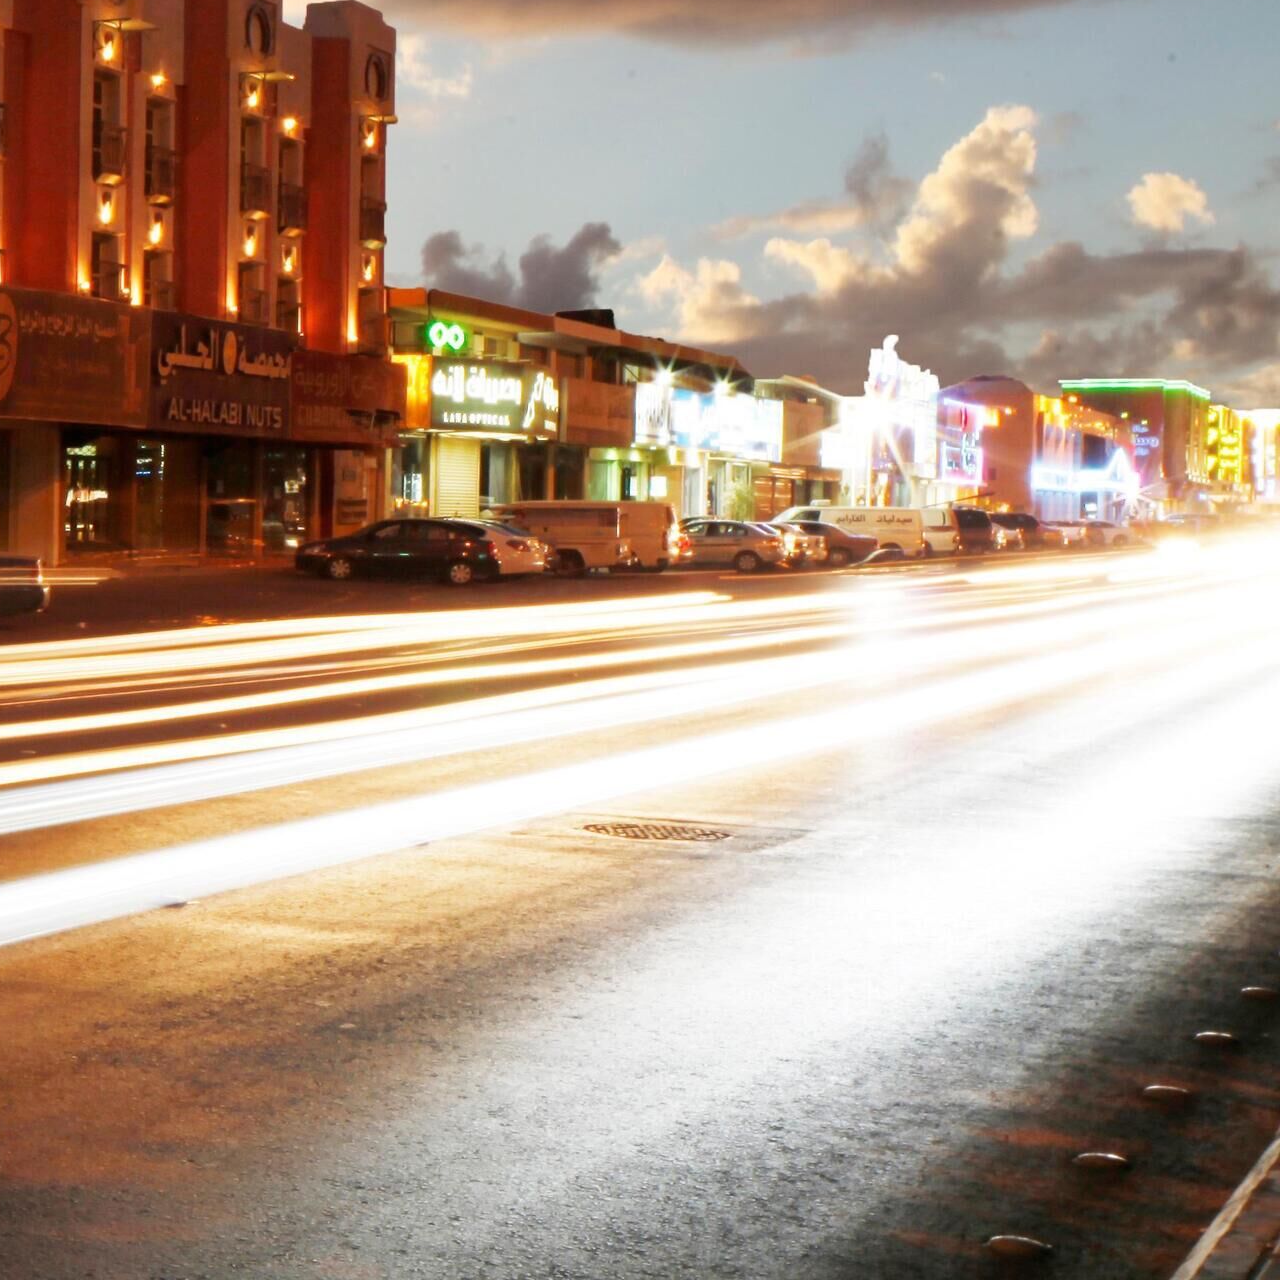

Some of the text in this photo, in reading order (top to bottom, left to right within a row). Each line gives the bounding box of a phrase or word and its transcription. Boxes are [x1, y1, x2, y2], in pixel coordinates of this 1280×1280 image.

[158, 323, 219, 384] الحلبي
[168, 397, 242, 425] AL-HALABI
[246, 404, 282, 429] NUTS
